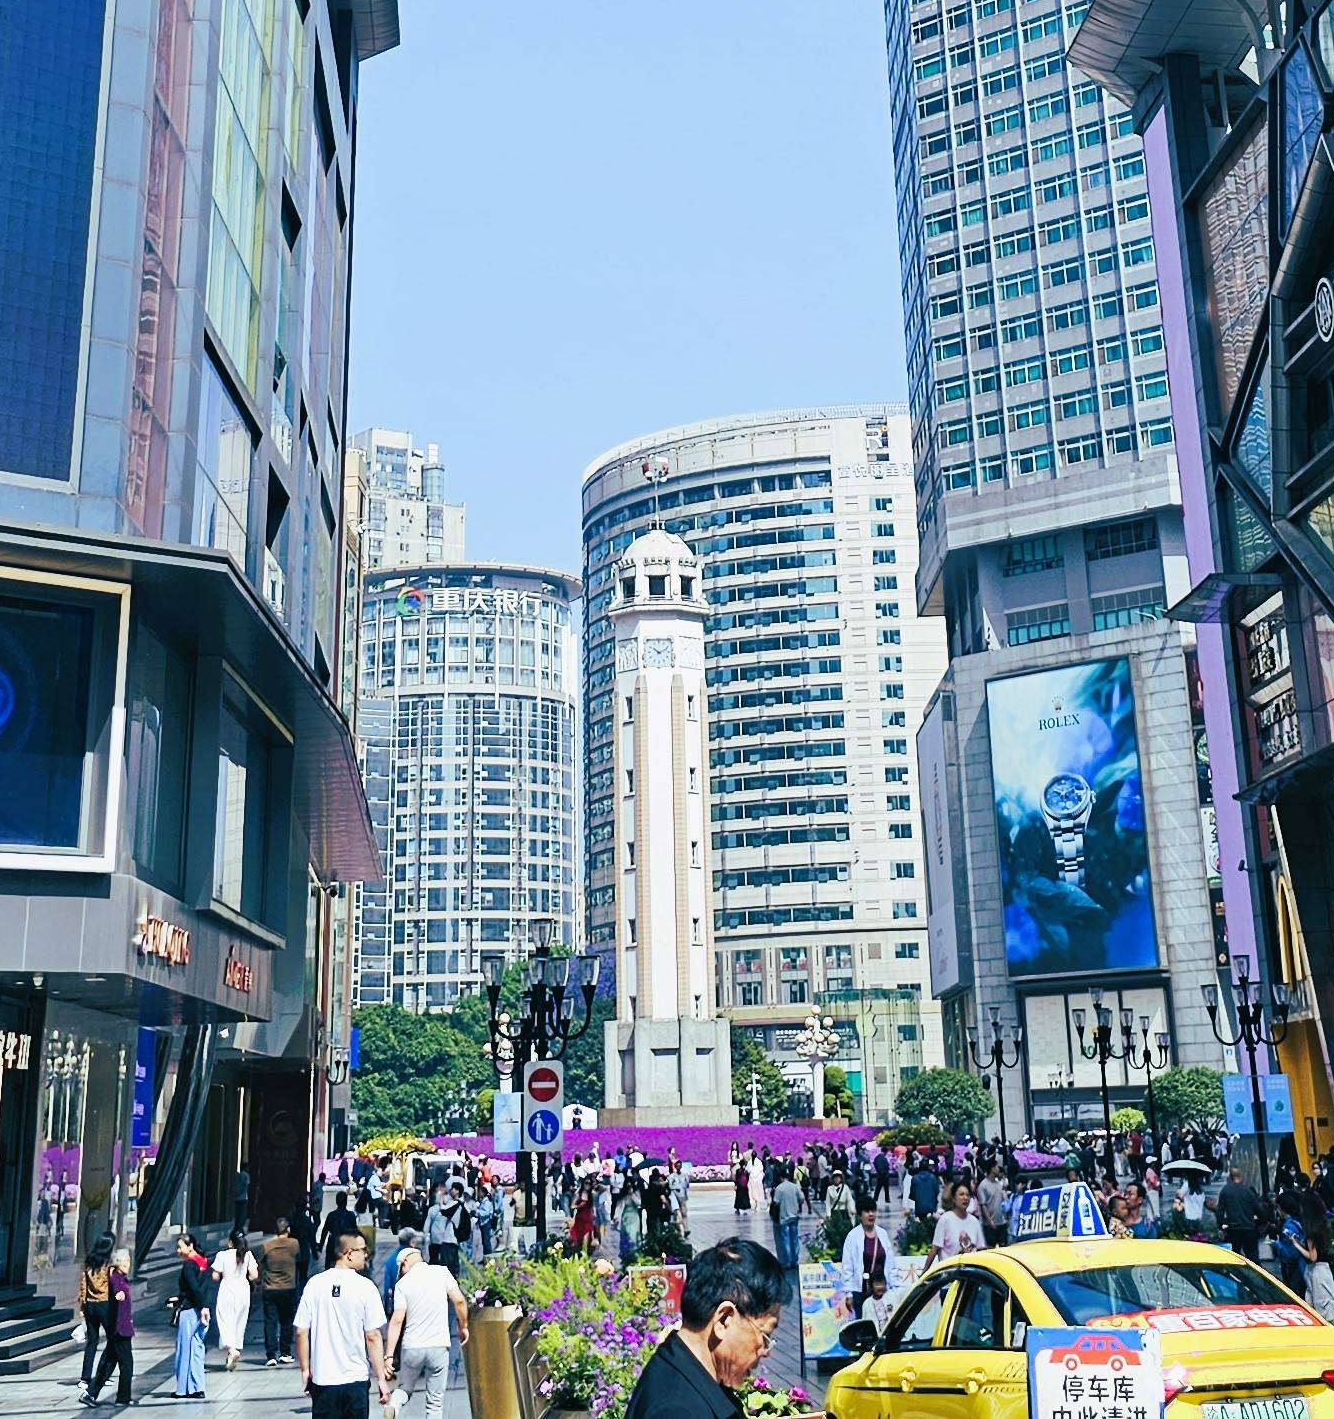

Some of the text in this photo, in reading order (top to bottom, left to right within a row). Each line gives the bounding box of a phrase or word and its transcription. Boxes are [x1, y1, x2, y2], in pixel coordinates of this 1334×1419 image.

[432, 587, 542, 616] 重庆银行
[1039, 713, 1081, 731] ROLEX
[1062, 1375, 1135, 1403] 停车库
